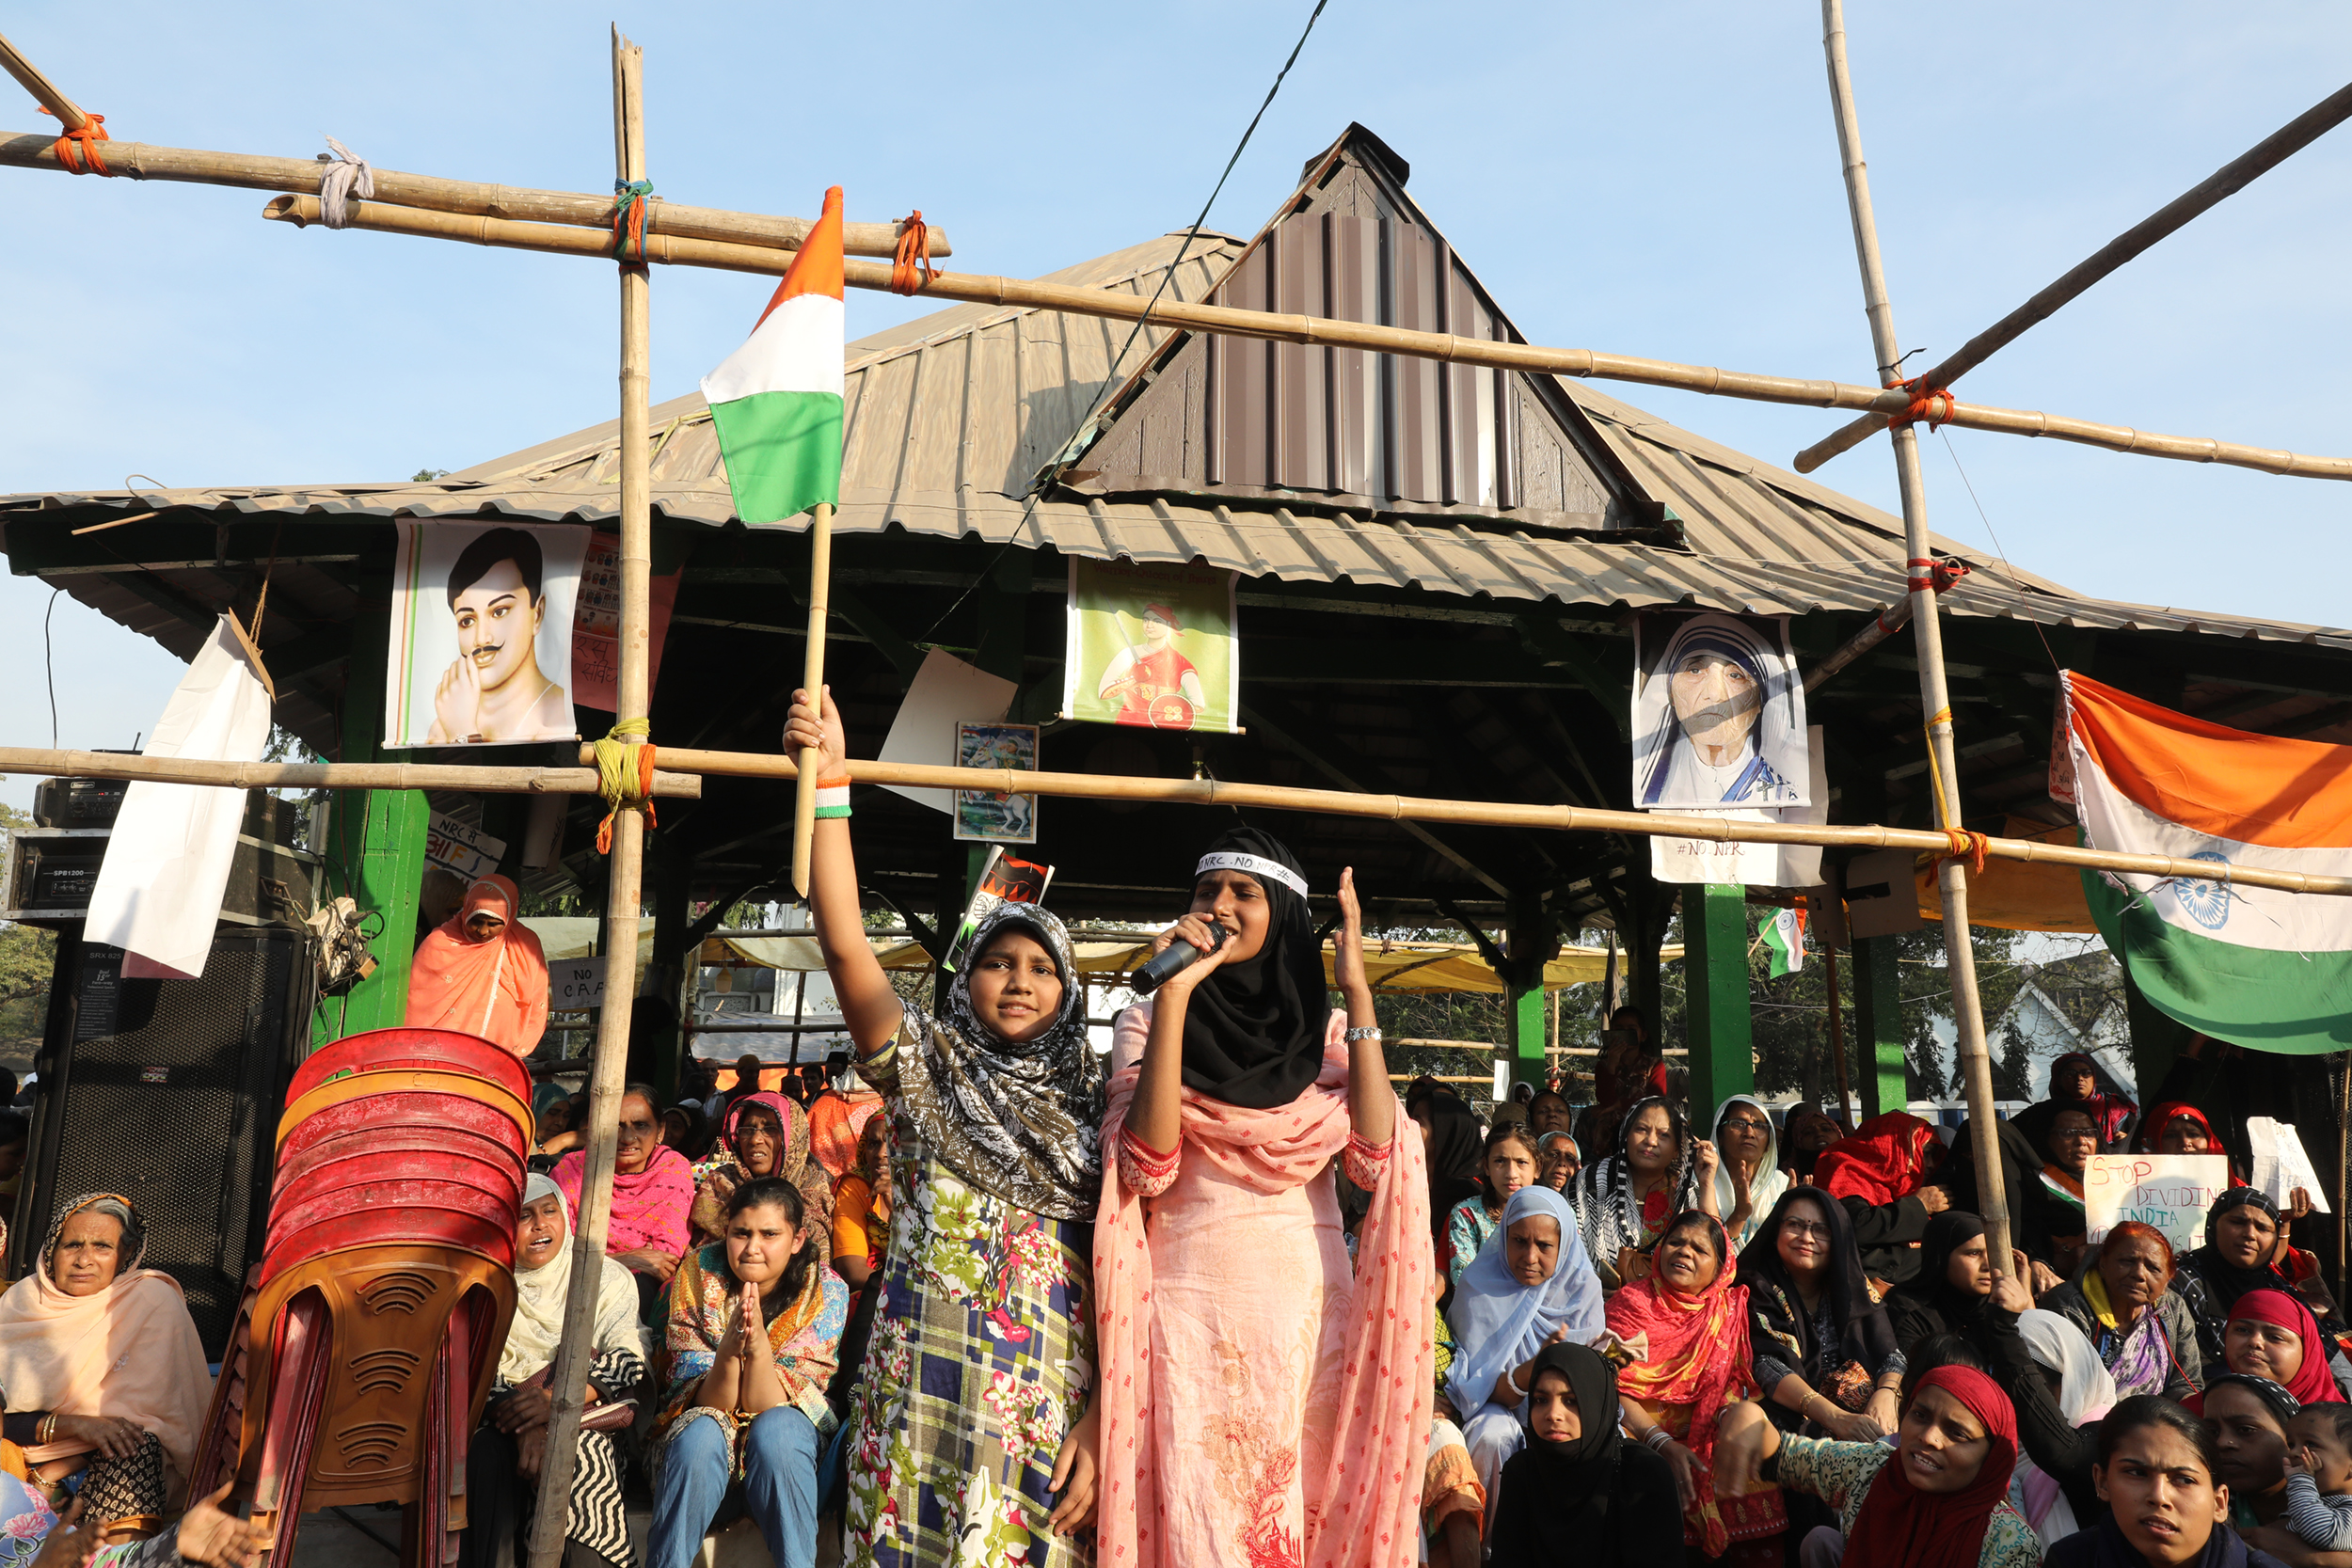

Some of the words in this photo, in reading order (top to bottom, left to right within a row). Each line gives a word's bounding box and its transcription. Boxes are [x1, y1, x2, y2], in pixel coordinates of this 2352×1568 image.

[438, 819, 465, 838] NRC
[573, 969, 592, 980] NO
[2091, 1156, 2153, 1186] STOP
[2117, 1207, 2180, 1227] INDIA
